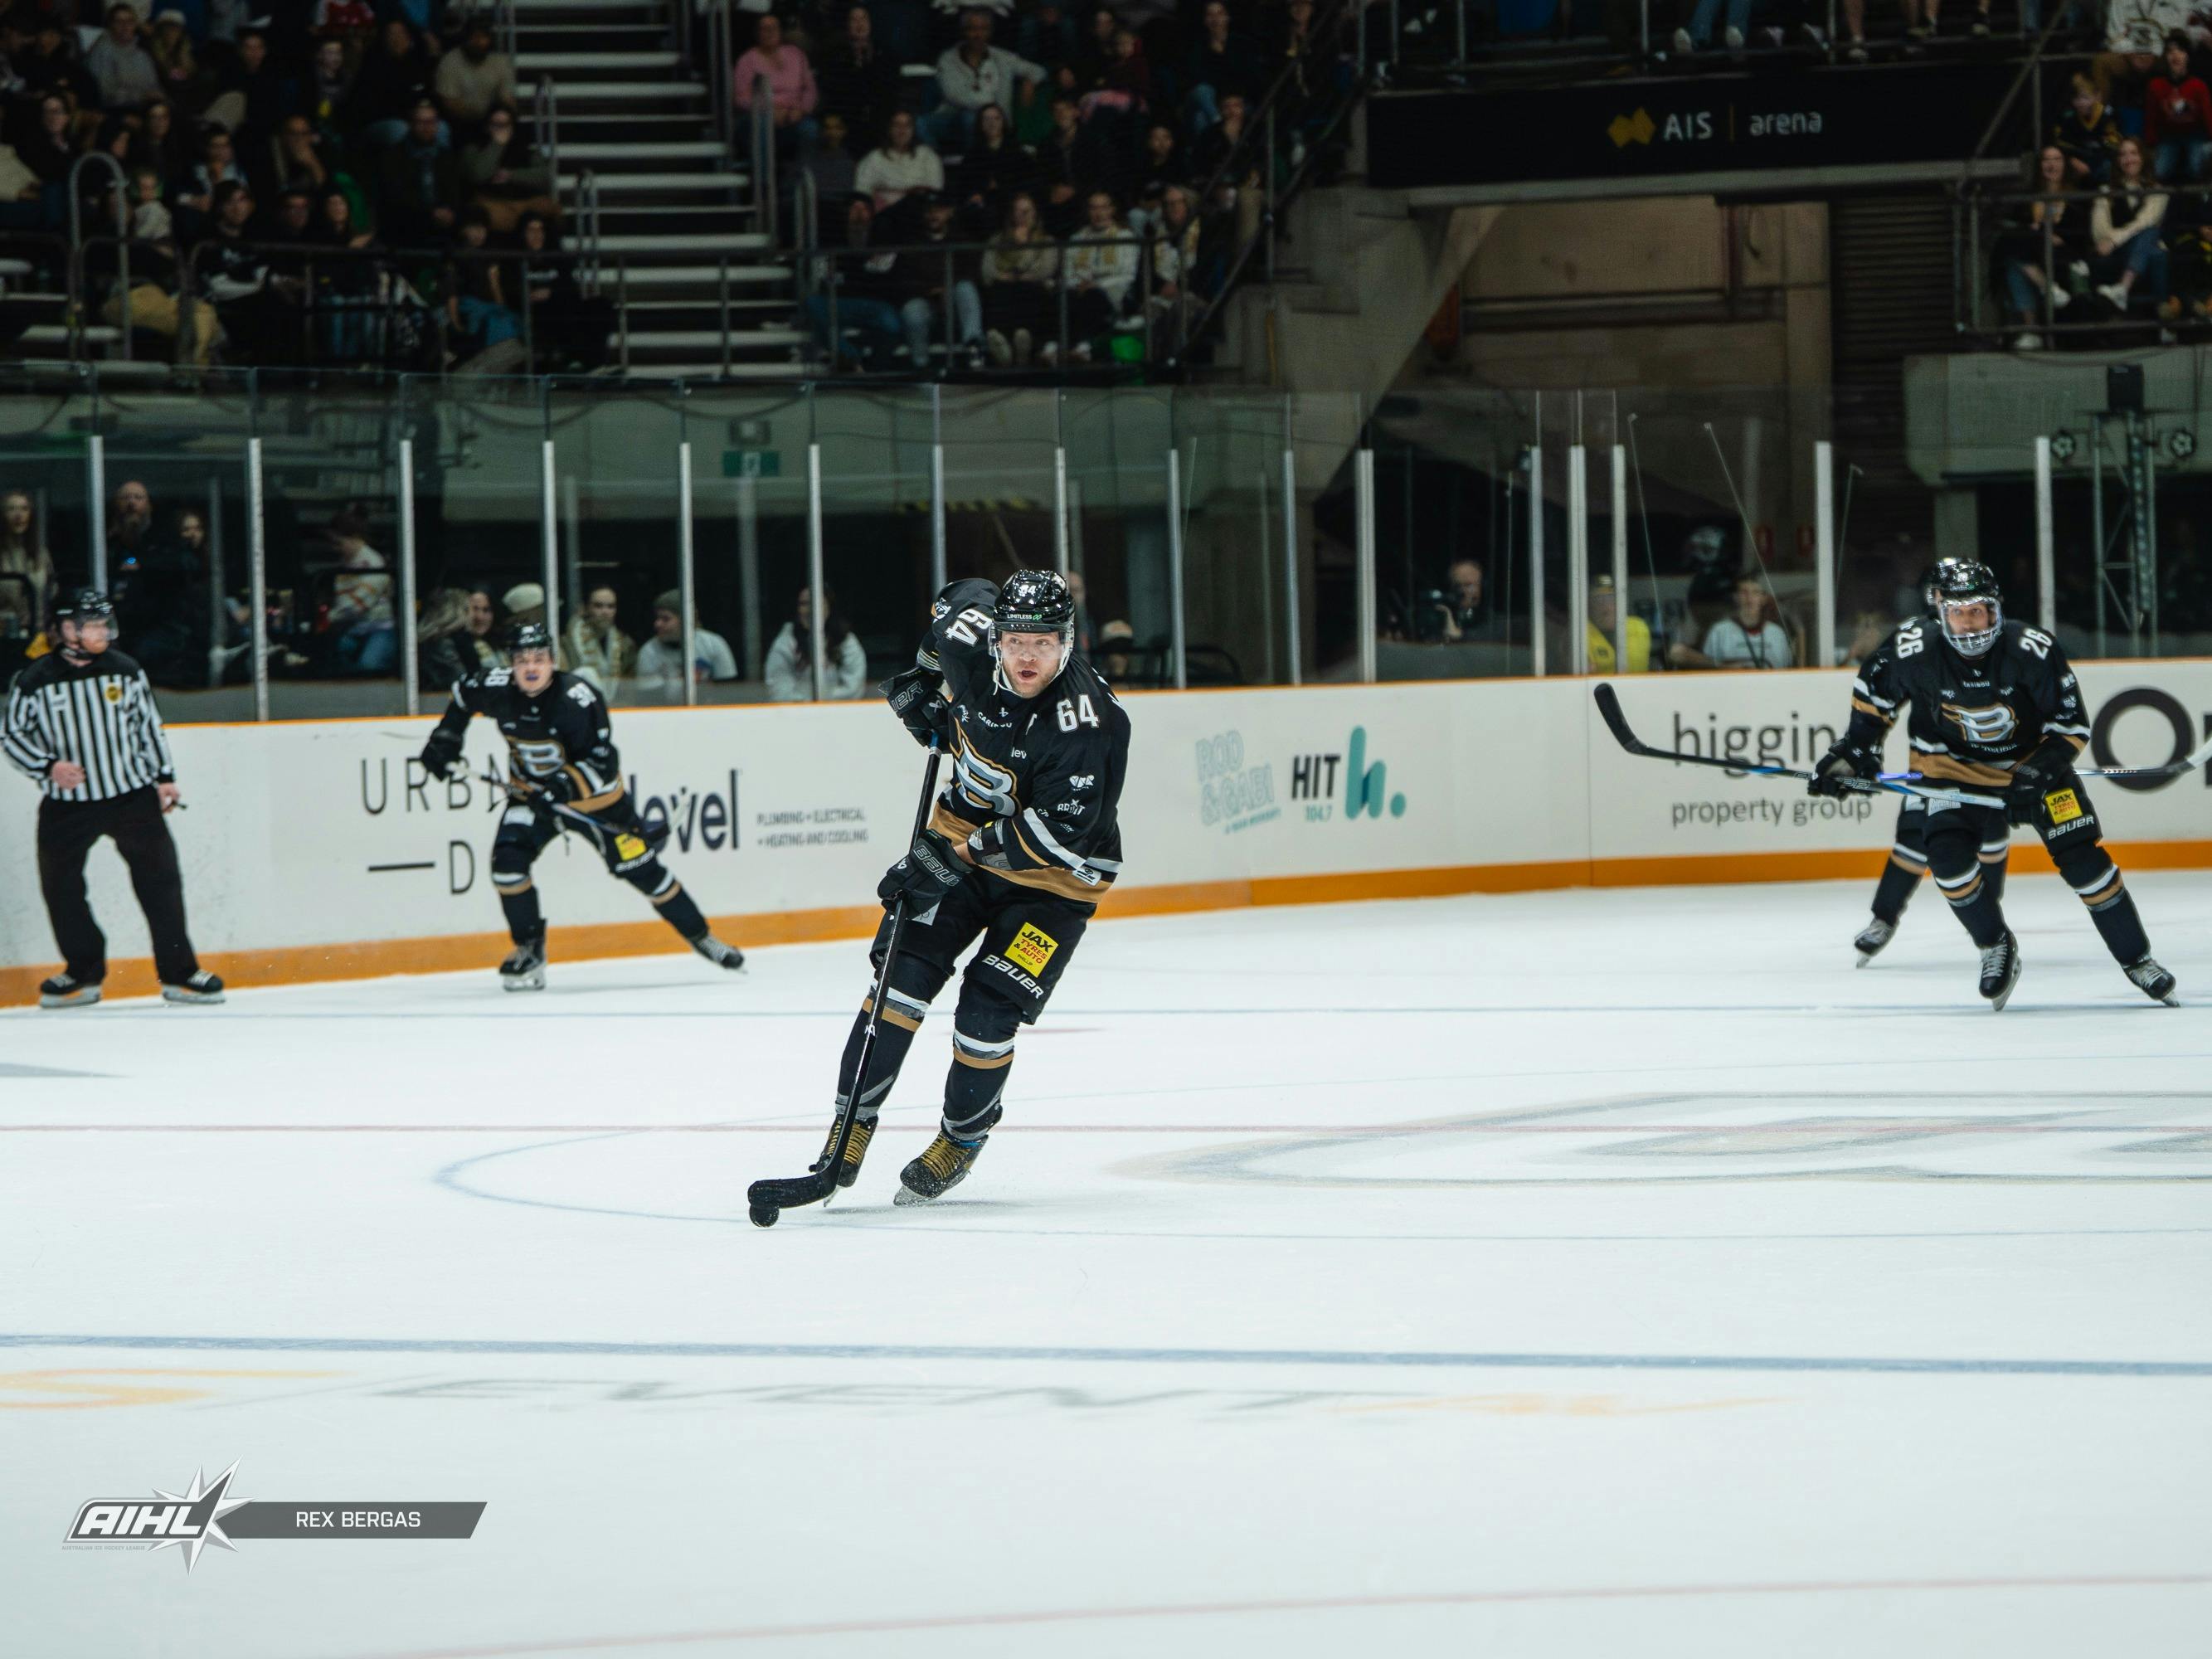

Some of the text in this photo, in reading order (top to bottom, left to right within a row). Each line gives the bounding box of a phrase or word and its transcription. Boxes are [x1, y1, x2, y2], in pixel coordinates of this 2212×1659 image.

[1663, 110, 1823, 142] AIS arena
[944, 607, 994, 647] 64
[1895, 627, 1925, 659] 26
[2019, 627, 2053, 660] 26
[978, 711, 1013, 728] CARIU
[1055, 693, 1100, 733] 64
[1672, 710, 1838, 778] higgin
[1291, 753, 1341, 800] HIT
[1672, 797, 1873, 830] property group
[2049, 815, 2095, 840] BAUER
[912, 844, 961, 887] BAU
[1020, 947, 1043, 965] AUTO
[1021, 938, 1048, 960] TYRES
[1022, 931, 1054, 953] JAX
[982, 954, 1044, 1000] BAUER
